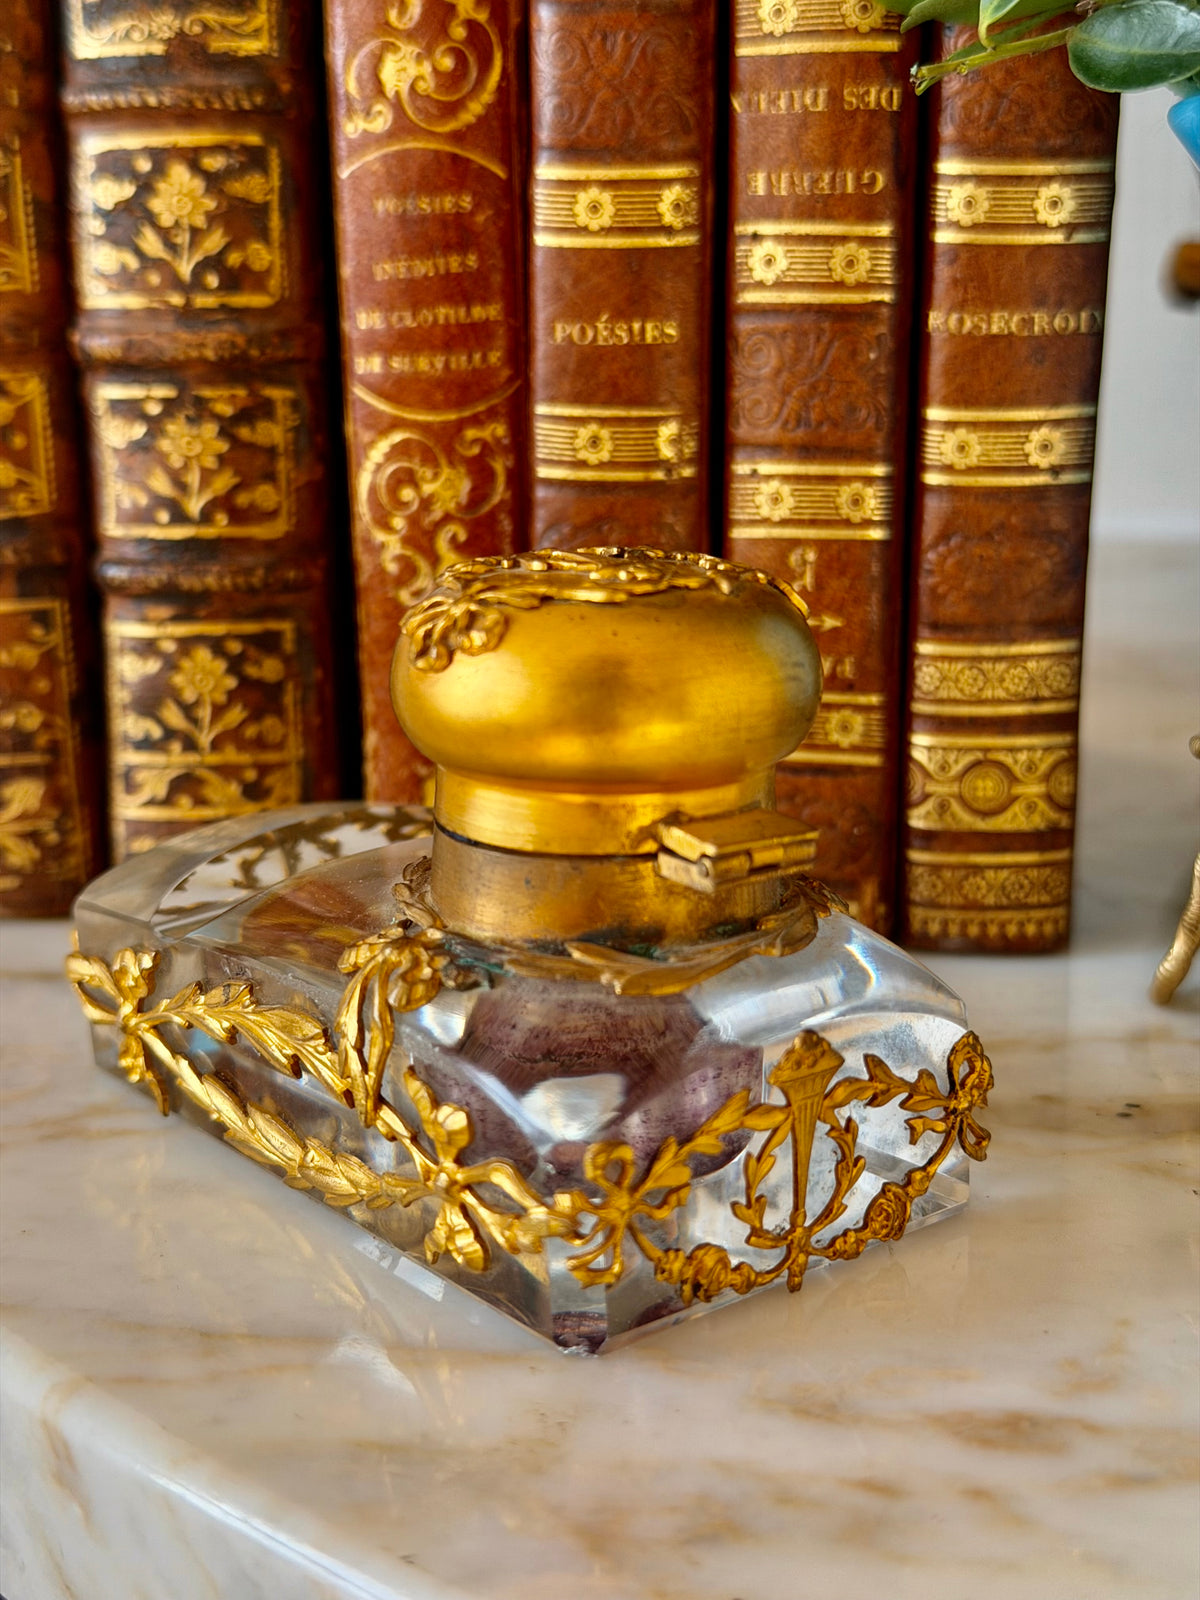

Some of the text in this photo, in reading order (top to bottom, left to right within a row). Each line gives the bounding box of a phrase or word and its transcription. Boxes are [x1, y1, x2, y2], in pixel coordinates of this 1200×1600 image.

[843, 86, 902, 112] DES
[747, 169, 886, 196] GUERRE
[550, 311, 679, 345] POÉSIES
